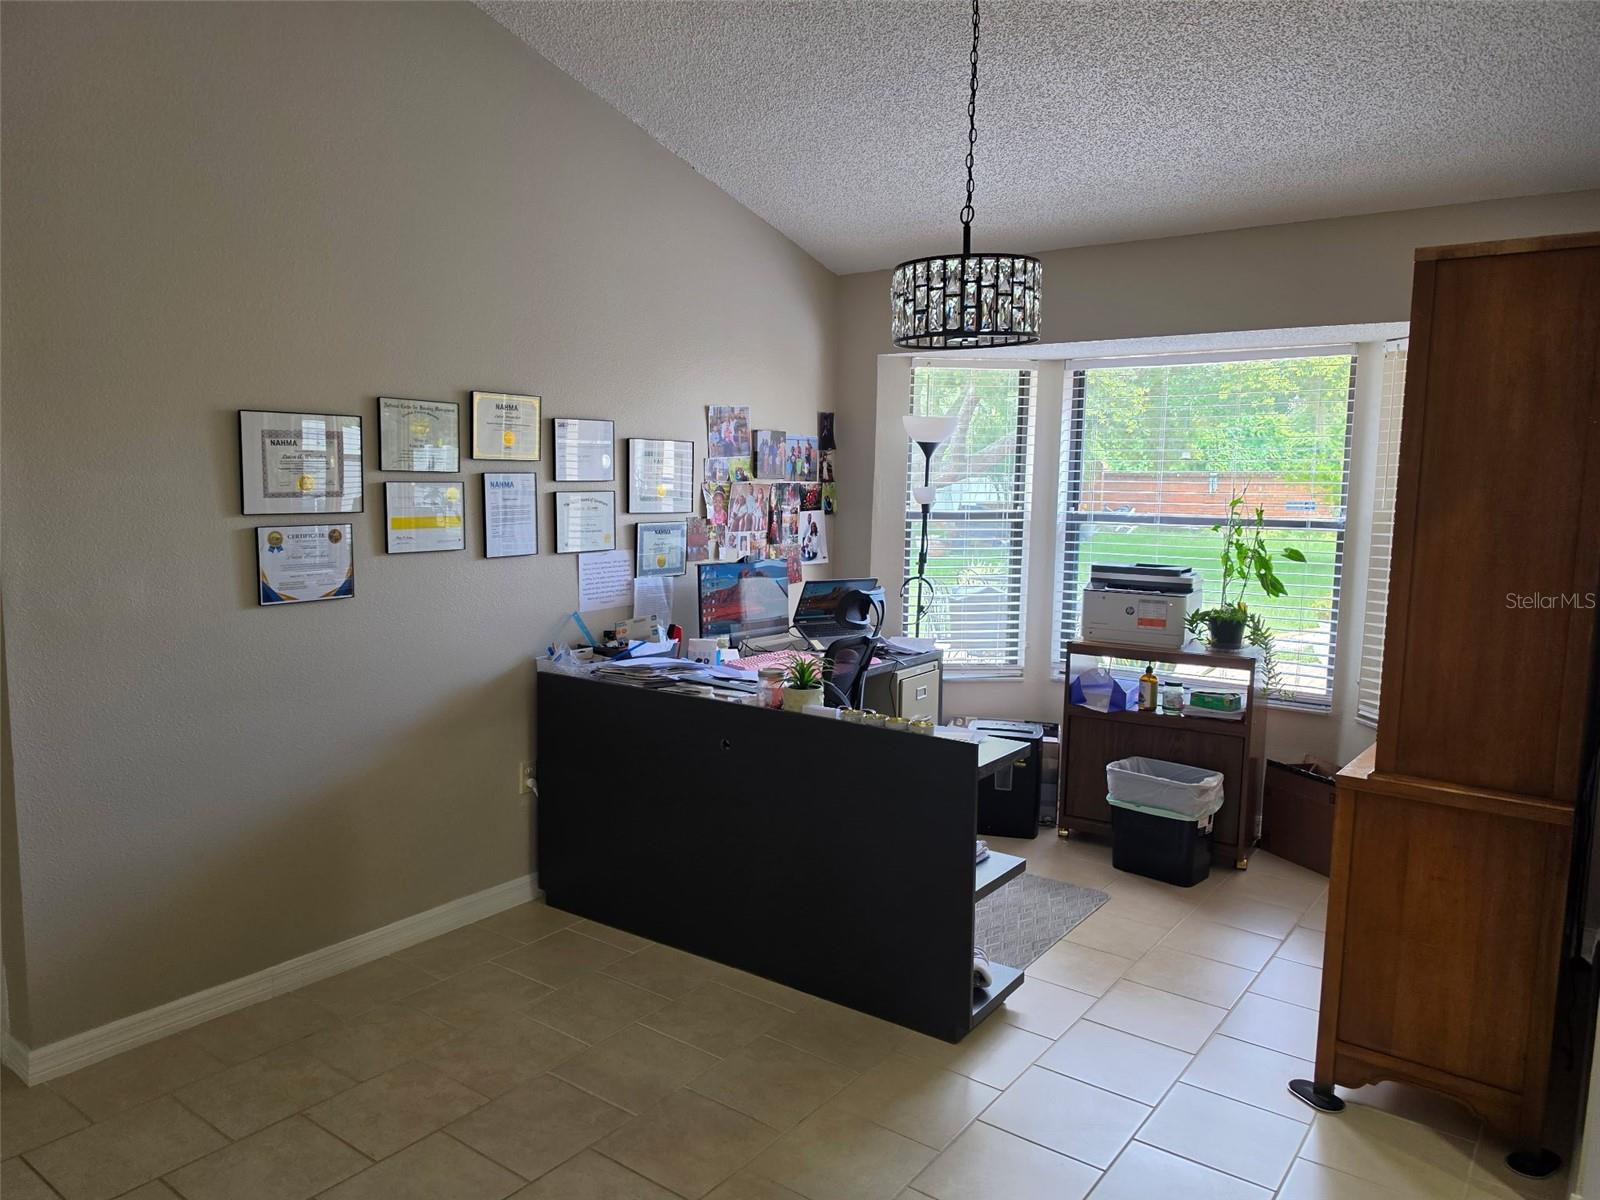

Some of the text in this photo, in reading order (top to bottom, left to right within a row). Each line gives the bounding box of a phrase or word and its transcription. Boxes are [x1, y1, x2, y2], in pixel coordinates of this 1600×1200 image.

[496, 403, 519, 411] NAHMA
[270, 439, 298, 447] NAHMA
[489, 481, 514, 489] NAHMA
